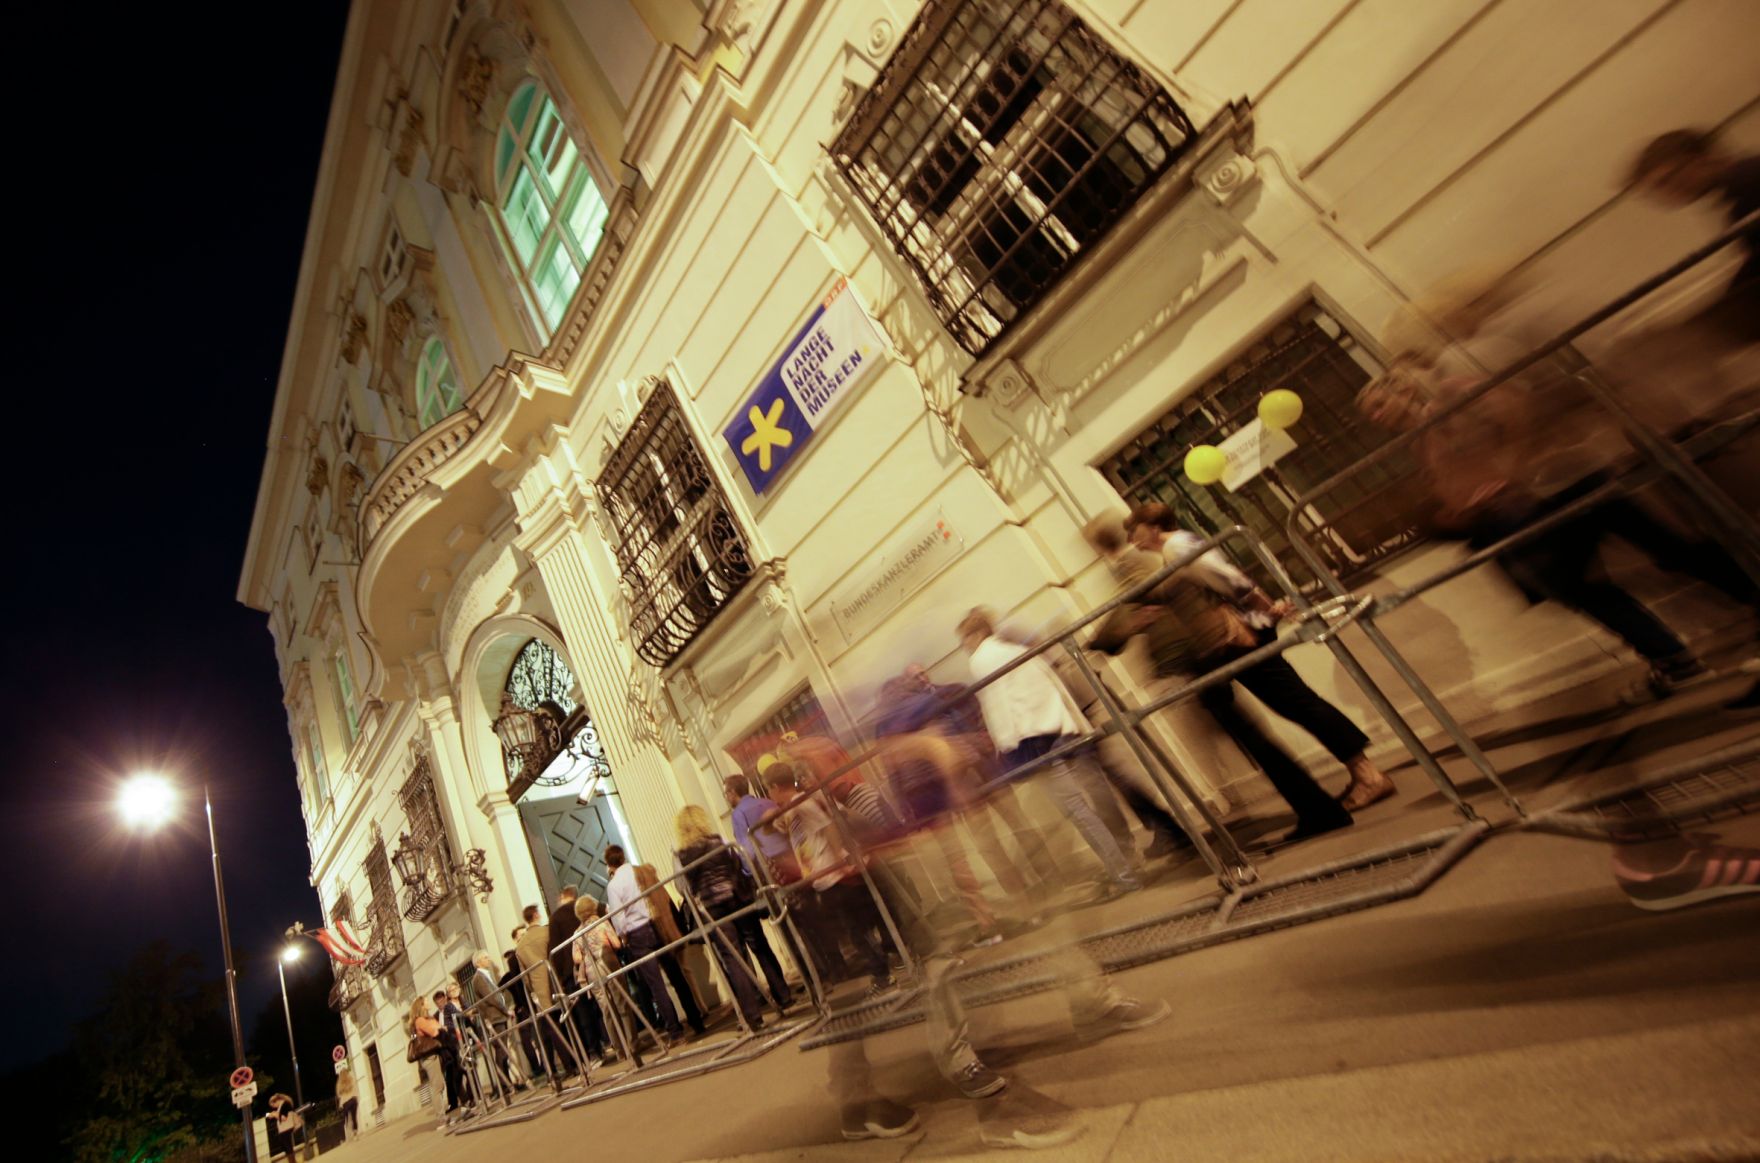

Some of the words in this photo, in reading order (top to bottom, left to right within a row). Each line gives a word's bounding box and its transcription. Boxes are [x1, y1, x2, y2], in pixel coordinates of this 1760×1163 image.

[786, 325, 831, 379] LANGE
[793, 338, 834, 391] NACHT
[799, 370, 828, 404] DER
[806, 349, 862, 416] MUSEEN
[842, 530, 939, 618] BUNDESKANZLERAMT
